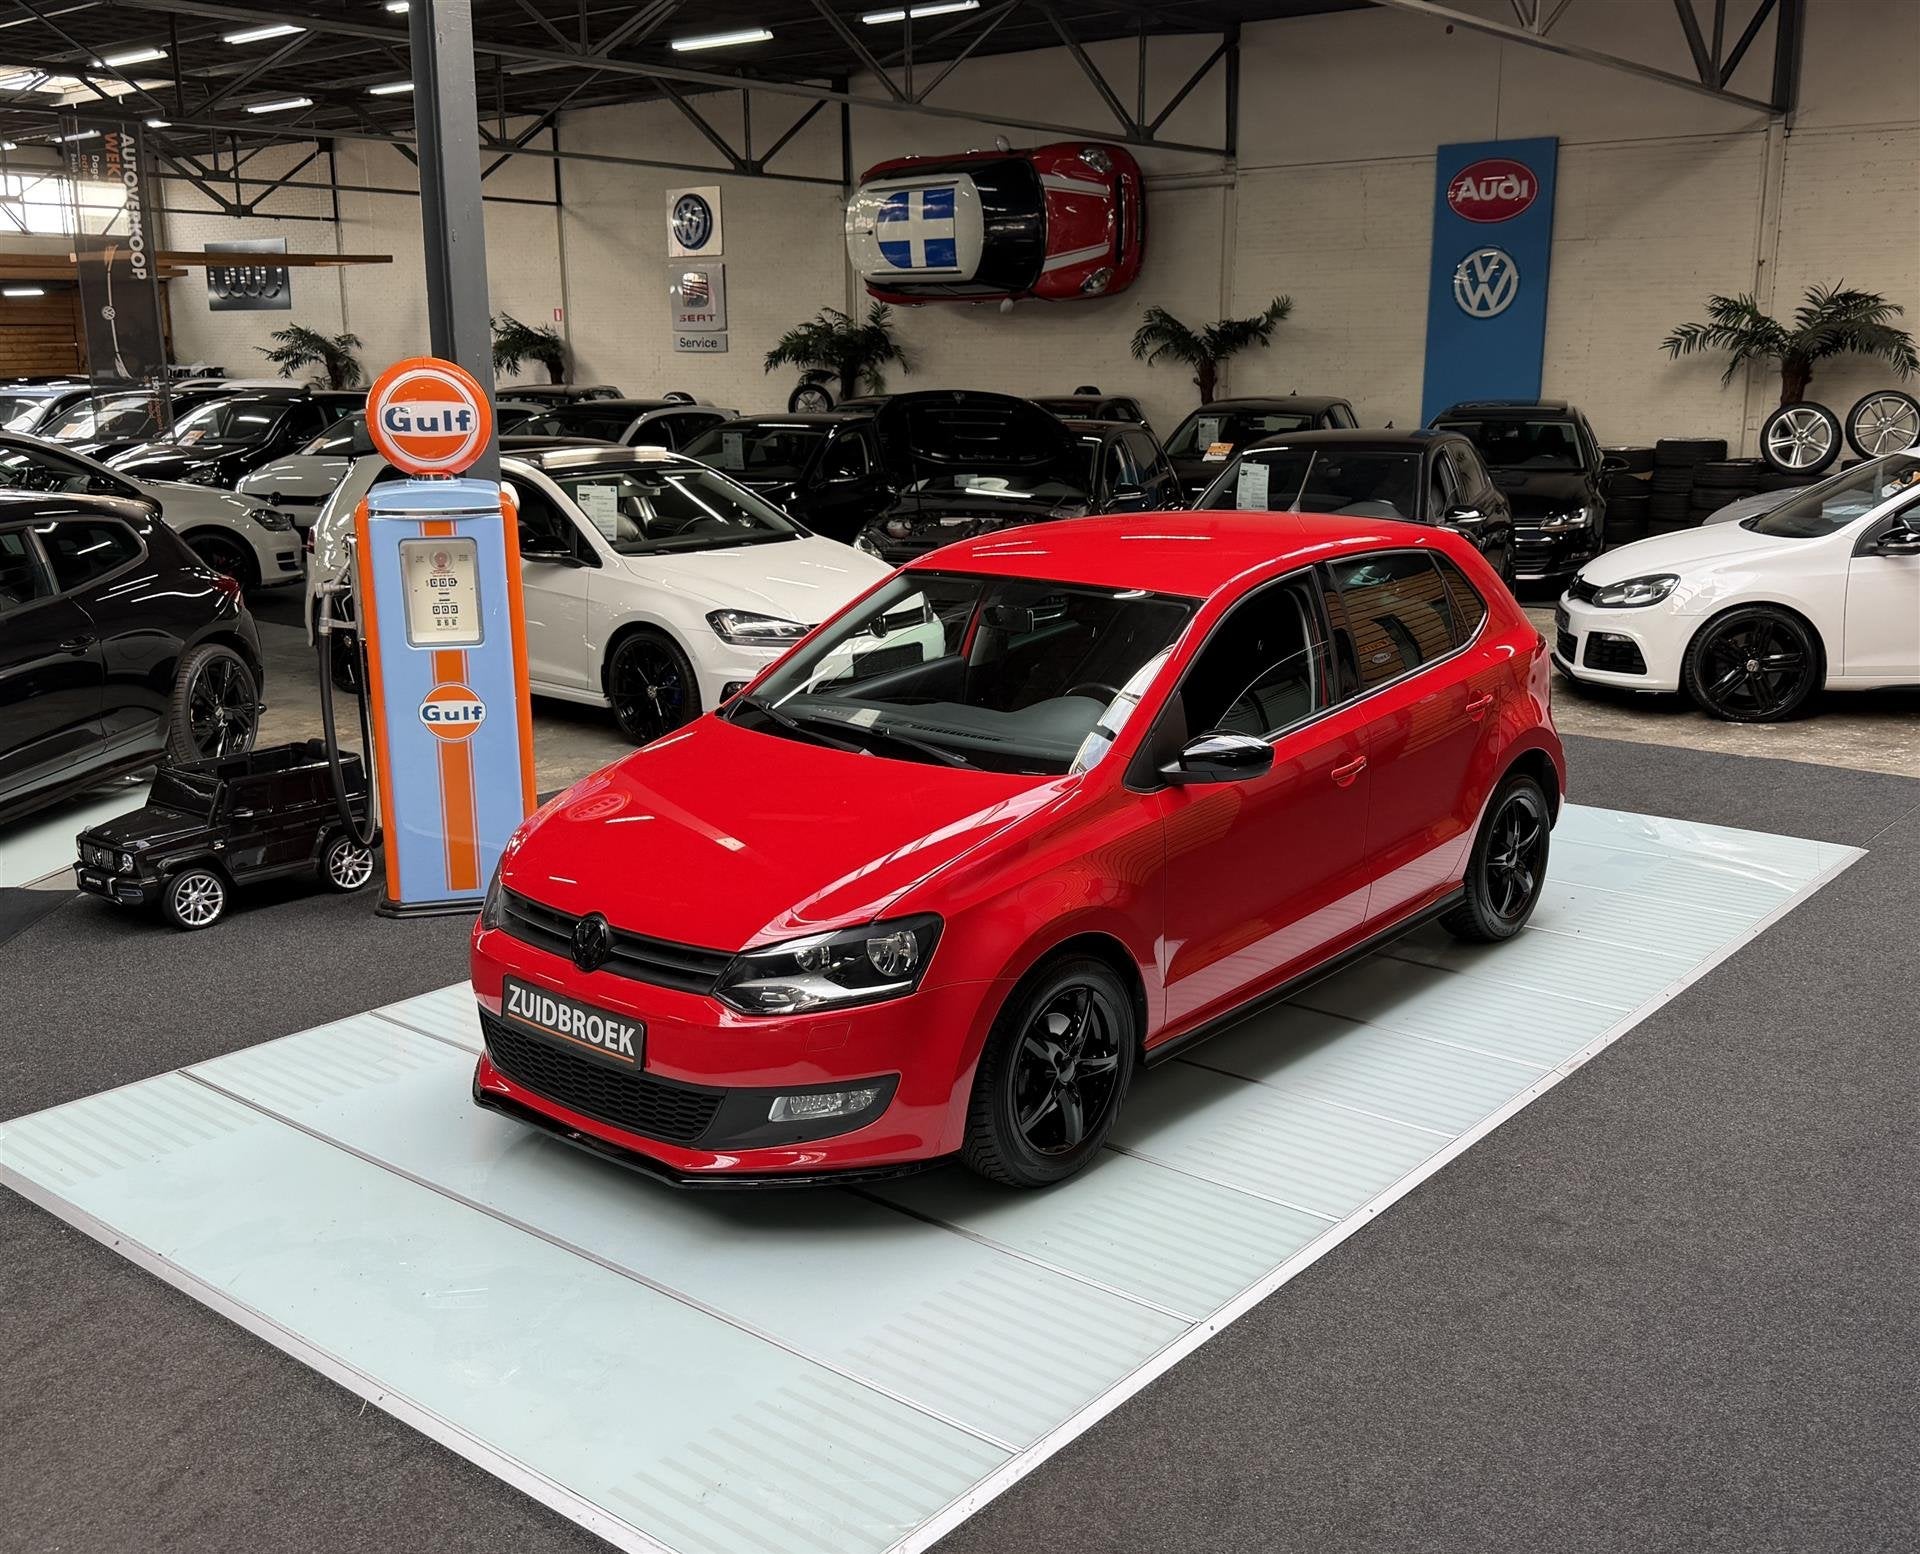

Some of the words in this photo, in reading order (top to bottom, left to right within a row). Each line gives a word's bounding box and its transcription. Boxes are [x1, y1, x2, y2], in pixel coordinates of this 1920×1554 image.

[120, 132, 148, 280] AUTOVERKOOP
[679, 336, 718, 349] Service
[384, 406, 471, 432] Gulf
[422, 704, 483, 721] Gulf
[507, 983, 636, 1057] ZUIDBROEK
